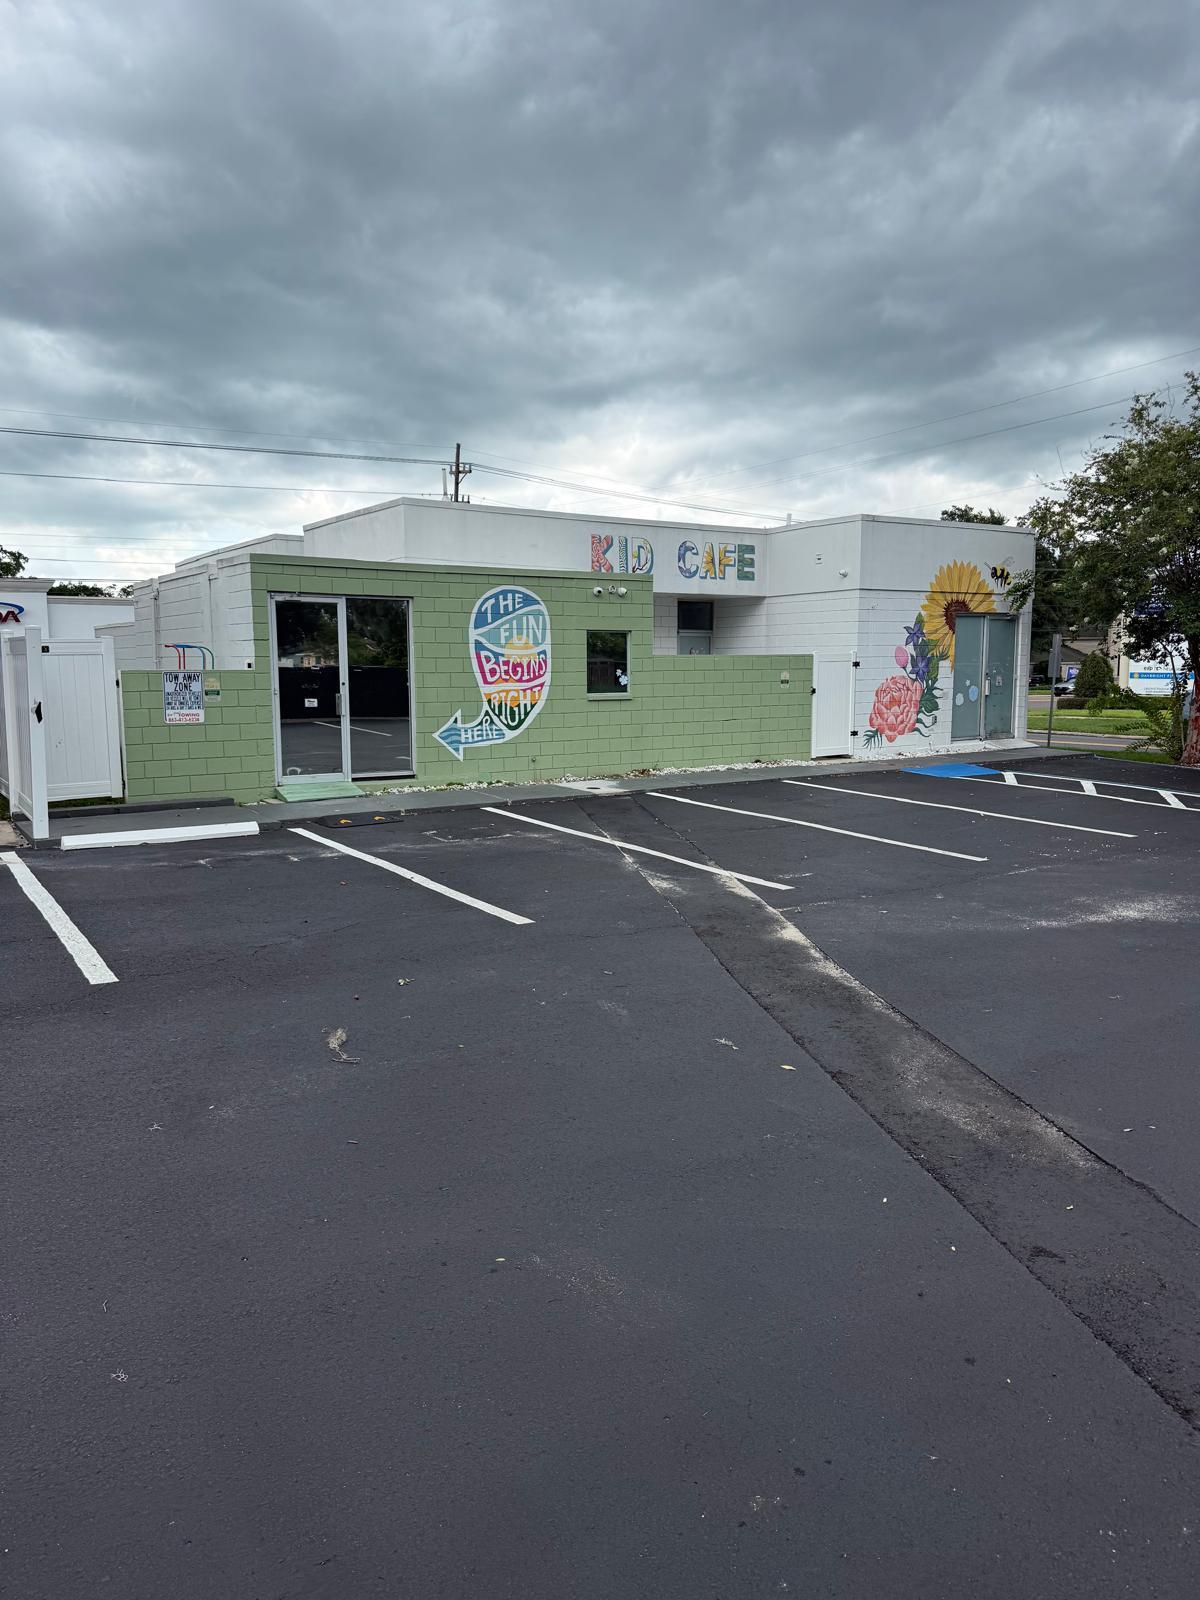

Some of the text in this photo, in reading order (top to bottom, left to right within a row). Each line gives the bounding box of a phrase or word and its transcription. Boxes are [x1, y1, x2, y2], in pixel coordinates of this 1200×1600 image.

[591, 533, 756, 581] KID CAFE
[481, 592, 524, 623] THE
[500, 615, 543, 646] FUN
[165, 673, 200, 682] TOW AWAY
[480, 650, 546, 682] BEGINS
[174, 682, 193, 691] ZONE
[490, 686, 542, 726] RIGHT
[461, 716, 501, 743] HERE
